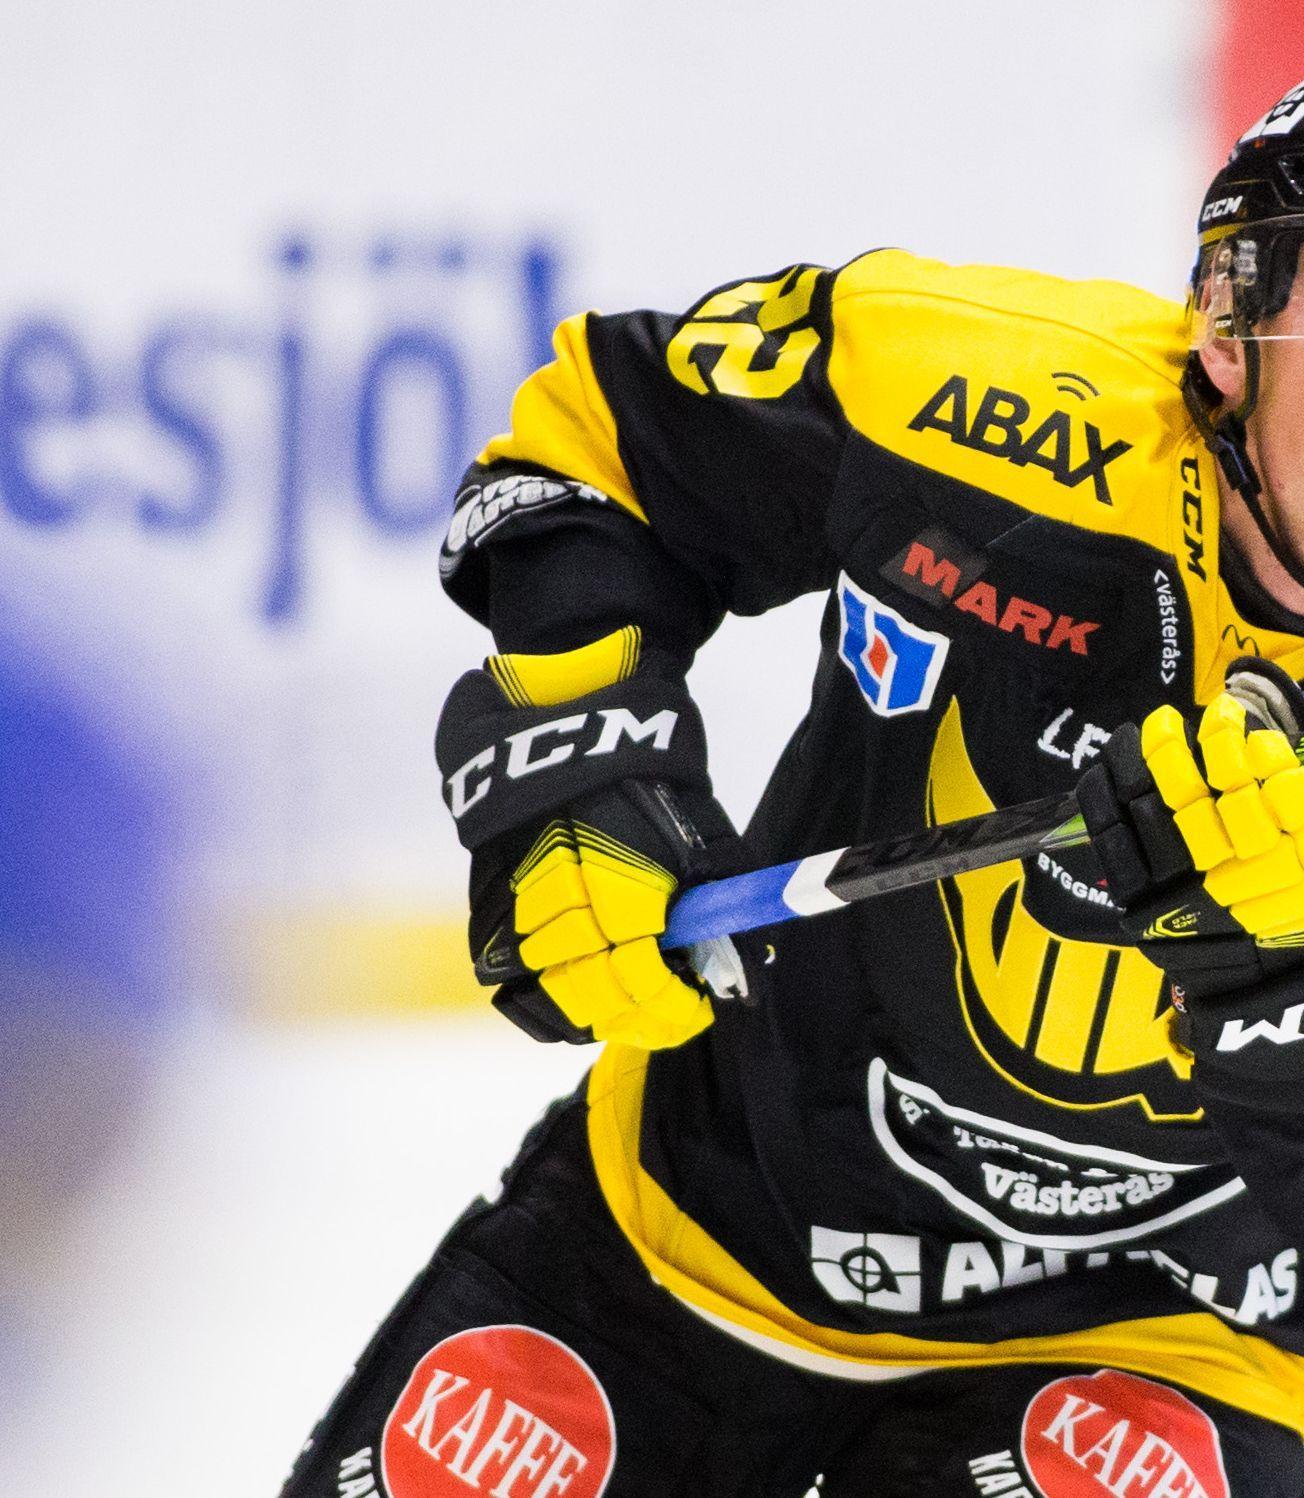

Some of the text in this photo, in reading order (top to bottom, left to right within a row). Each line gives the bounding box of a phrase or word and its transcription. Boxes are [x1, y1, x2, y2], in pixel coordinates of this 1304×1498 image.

[1201, 196, 1243, 222] CCM
[666, 264, 821, 398] 22
[908, 375, 1133, 506] ABAX
[1180, 457, 1207, 583] CCM
[902, 542, 1100, 656] MARK
[447, 708, 679, 820] CCM
[1041, 1393, 1210, 1498] KAFF
